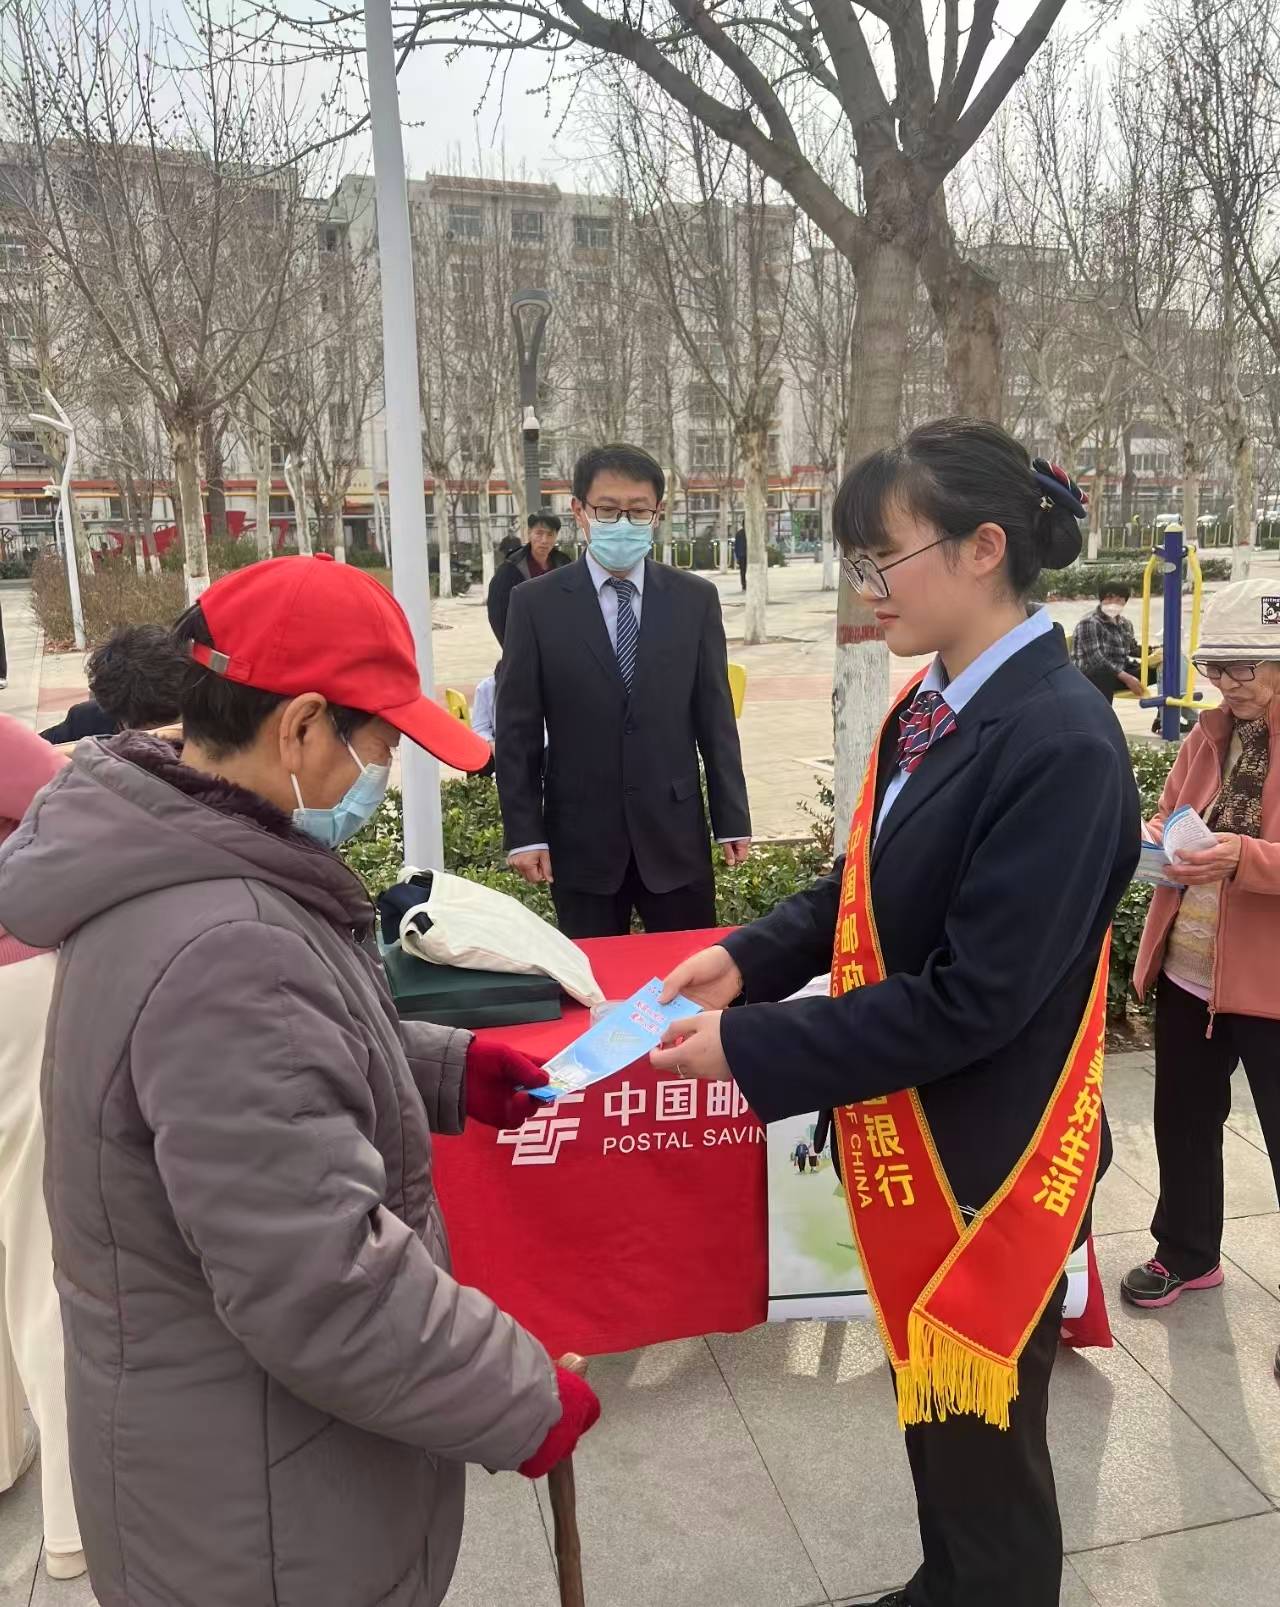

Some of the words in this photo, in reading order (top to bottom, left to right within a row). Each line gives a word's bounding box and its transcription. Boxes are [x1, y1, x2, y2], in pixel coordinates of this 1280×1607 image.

[603, 1130, 694, 1155] POSTAL
[1033, 1034, 1105, 1217] 美好生活
[850, 1133, 873, 1208] CHINA
